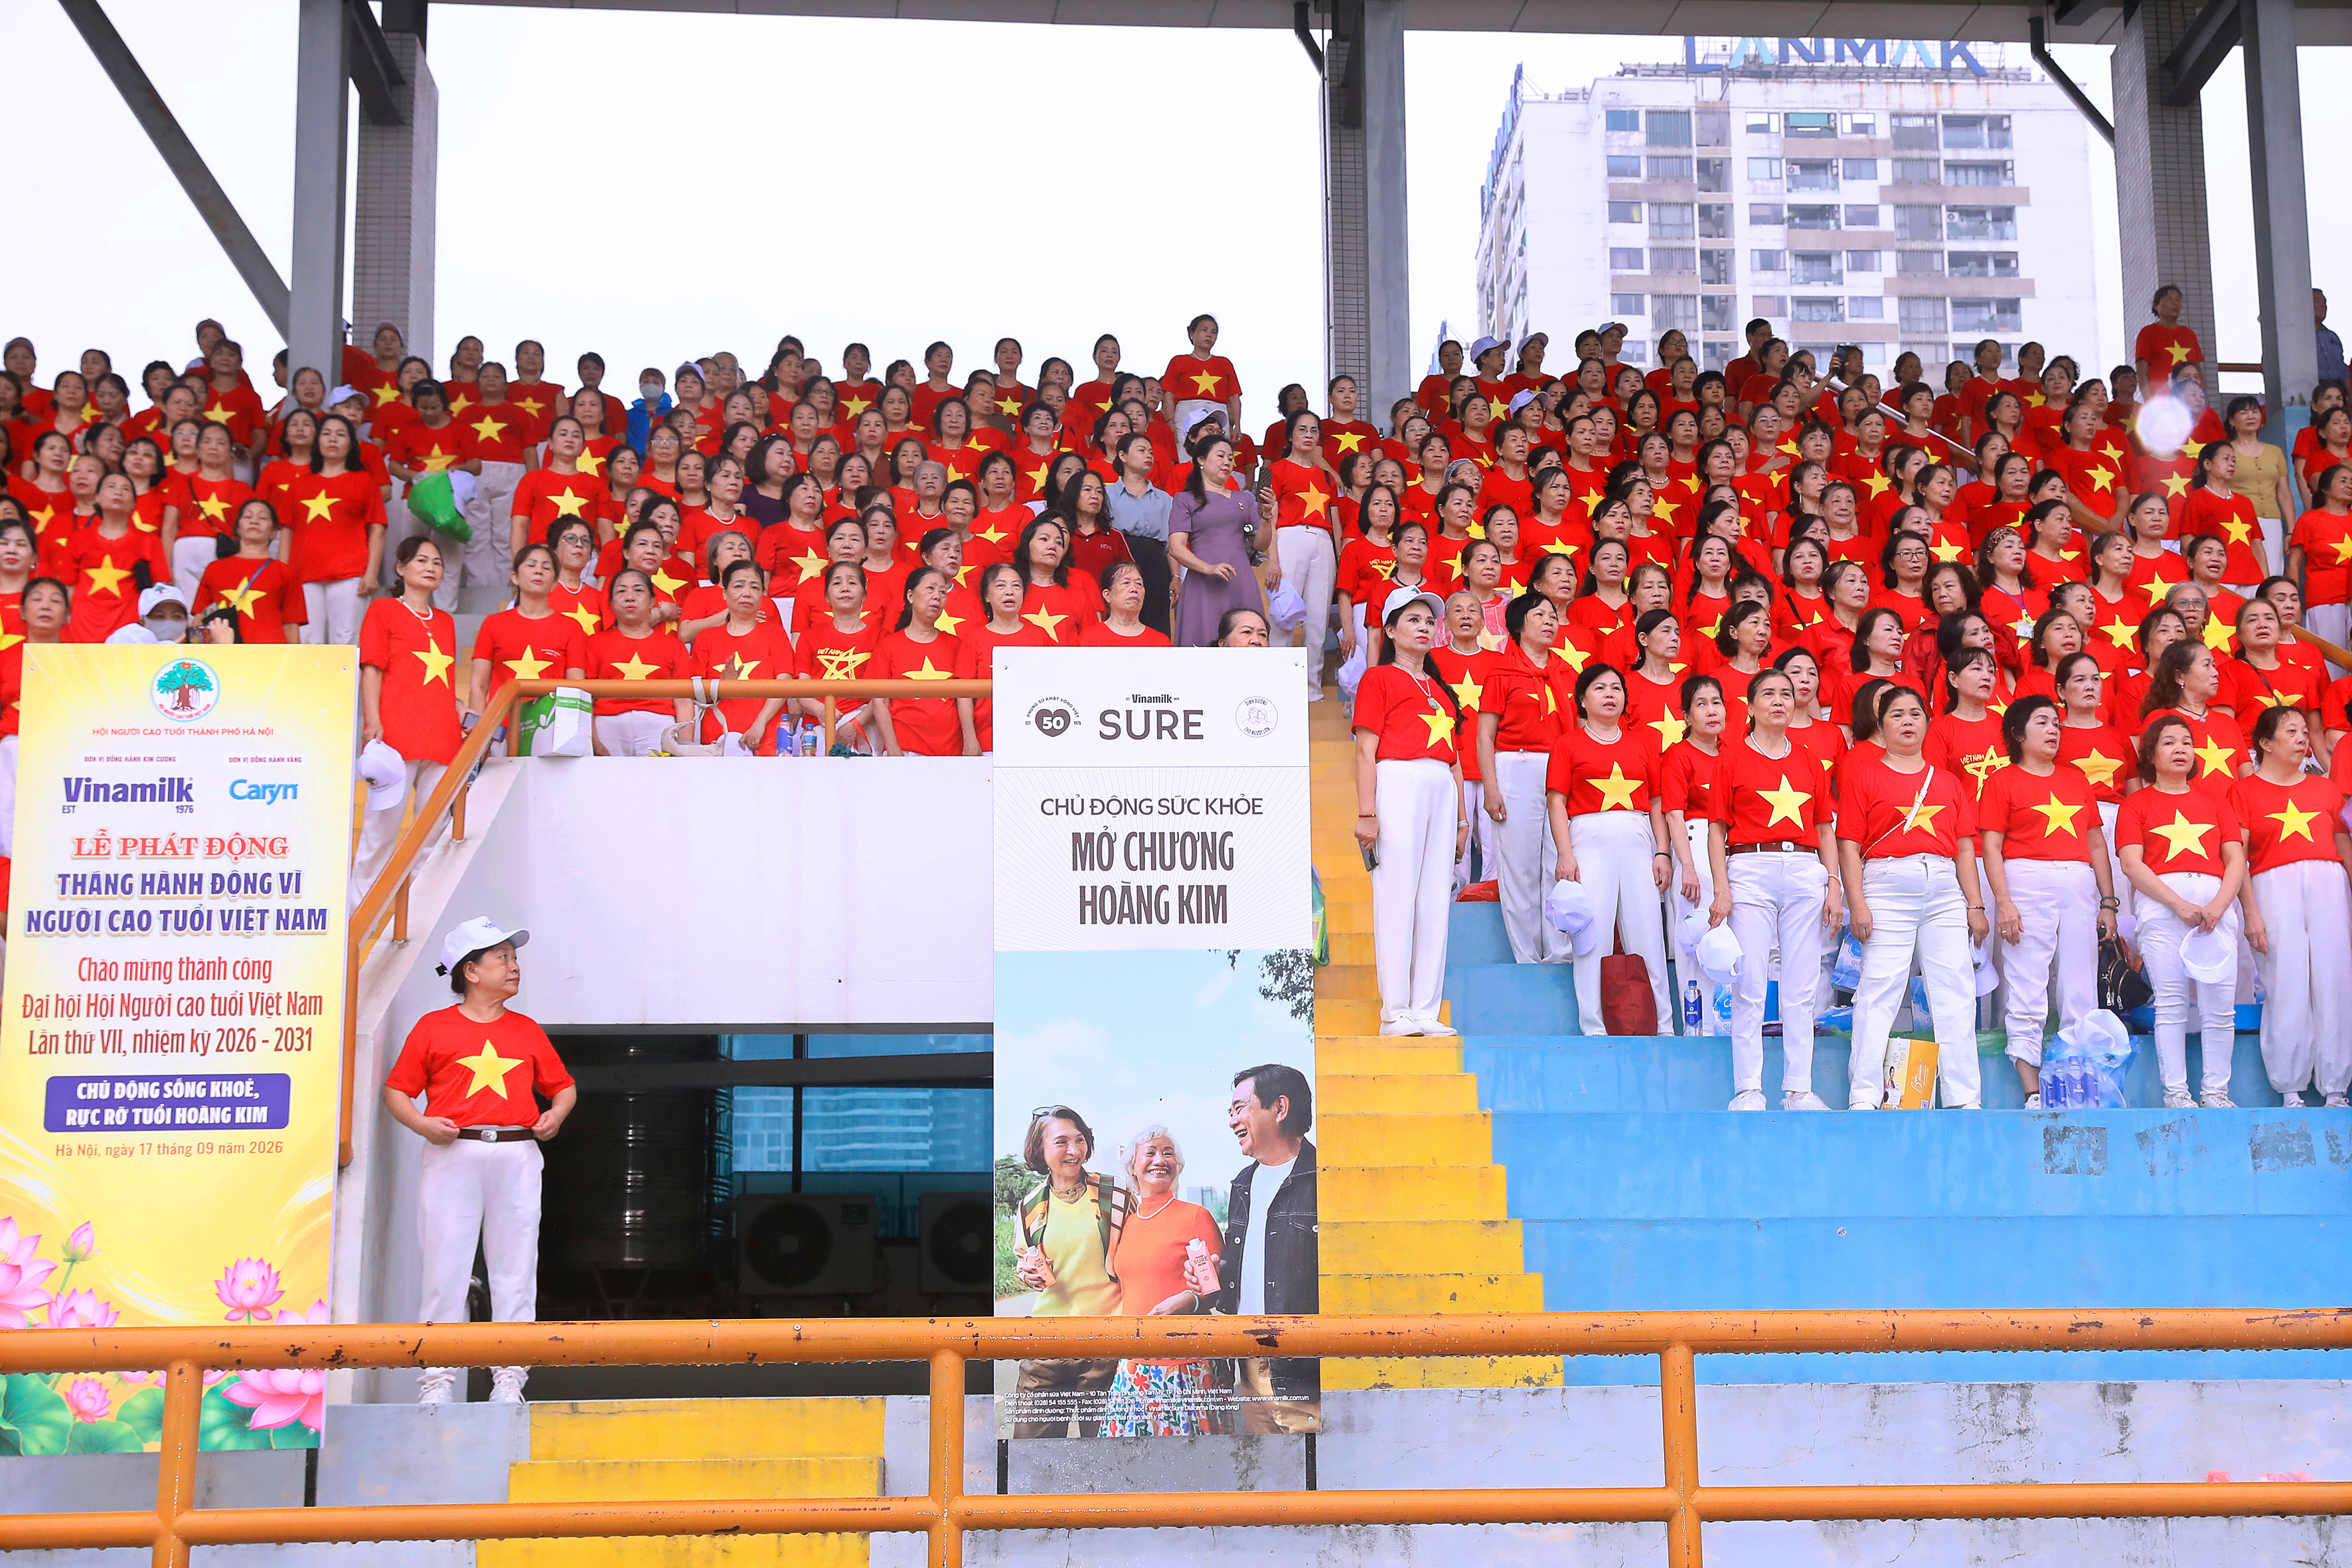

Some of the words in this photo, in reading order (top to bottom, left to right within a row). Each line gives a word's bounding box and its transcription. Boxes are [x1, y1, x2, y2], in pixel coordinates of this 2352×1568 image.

[1131, 694, 1172, 704] Vinamilk
[1042, 716, 1065, 730] 50
[1099, 709, 1204, 740] SURE
[1960, 754, 1972, 765] VIỆT
[63, 777, 193, 803] Vinamilk
[229, 779, 299, 805] Caryn
[62, 805, 76, 814] EST
[175, 805, 194, 814] 1976
[1041, 794, 1085, 815] CHỦ
[1089, 795, 1154, 818] ĐỘNG
[1158, 795, 1200, 815] SỨC
[1206, 794, 1263, 815] KHỎE
[72, 829, 112, 856] LỄ
[119, 832, 198, 856] PHÁT
[205, 832, 289, 862] ĐỘNG
[1071, 826, 1117, 871] MỞ
[1123, 831, 1233, 871] CHƯƠNG
[58, 871, 133, 896] THÁNG
[140, 870, 204, 896] HÀNH
[210, 870, 272, 898] ĐỘNG
[279, 870, 302, 895] VÌ
[1079, 880, 1170, 925] HOÀNG
[1178, 884, 1227, 924] KIM
[27, 908, 102, 933] NGƯỜI
[108, 909, 152, 932] CAO
[159, 904, 213, 932] TUỔI
[220, 906, 270, 933] VIỆT
[275, 908, 327, 931] NAM
[78, 956, 118, 981] Chào
[123, 959, 173, 985] mừng
[178, 956, 227, 981] thành
[232, 957, 272, 984] công
[23, 994, 49, 1021] Đại
[54, 993, 81, 1021] hội
[86, 993, 114, 1021] Hội
[119, 993, 171, 1021] Người
[177, 997, 204, 1017] cao
[211, 990, 243, 1017] tuổi
[248, 992, 283, 1018] Việt
[287, 990, 323, 1016] Nam
[29, 1030, 58, 1054] Lần
[65, 1029, 94, 1054] thứ
[100, 1029, 126, 1057] VII,
[133, 1029, 185, 1056] nhiệm
[190, 1028, 211, 1057] kỳ
[215, 1028, 256, 1053] 2026
[275, 1026, 312, 1052] 2031
[76, 1079, 111, 1100] CHỦ
[114, 1079, 160, 1101] ĐỘNG
[163, 1078, 206, 1099] SỐNG
[66, 1109, 101, 1128] RỰC
[104, 1106, 129, 1126] RỠ
[131, 1105, 172, 1125] TUỔI
[175, 1105, 232, 1125] HOÀNG
[234, 1106, 268, 1123] KIM
[56, 1144, 72, 1156] Hà
[77, 1143, 101, 1159] Nội,
[105, 1147, 134, 1158] ngày
[139, 1143, 153, 1155] 17
[157, 1142, 193, 1158] tháng
[196, 1142, 214, 1154] 09
[219, 1143, 244, 1154] năm
[250, 1140, 283, 1154] 2026
[1194, 1256, 1208, 1265] SURE
